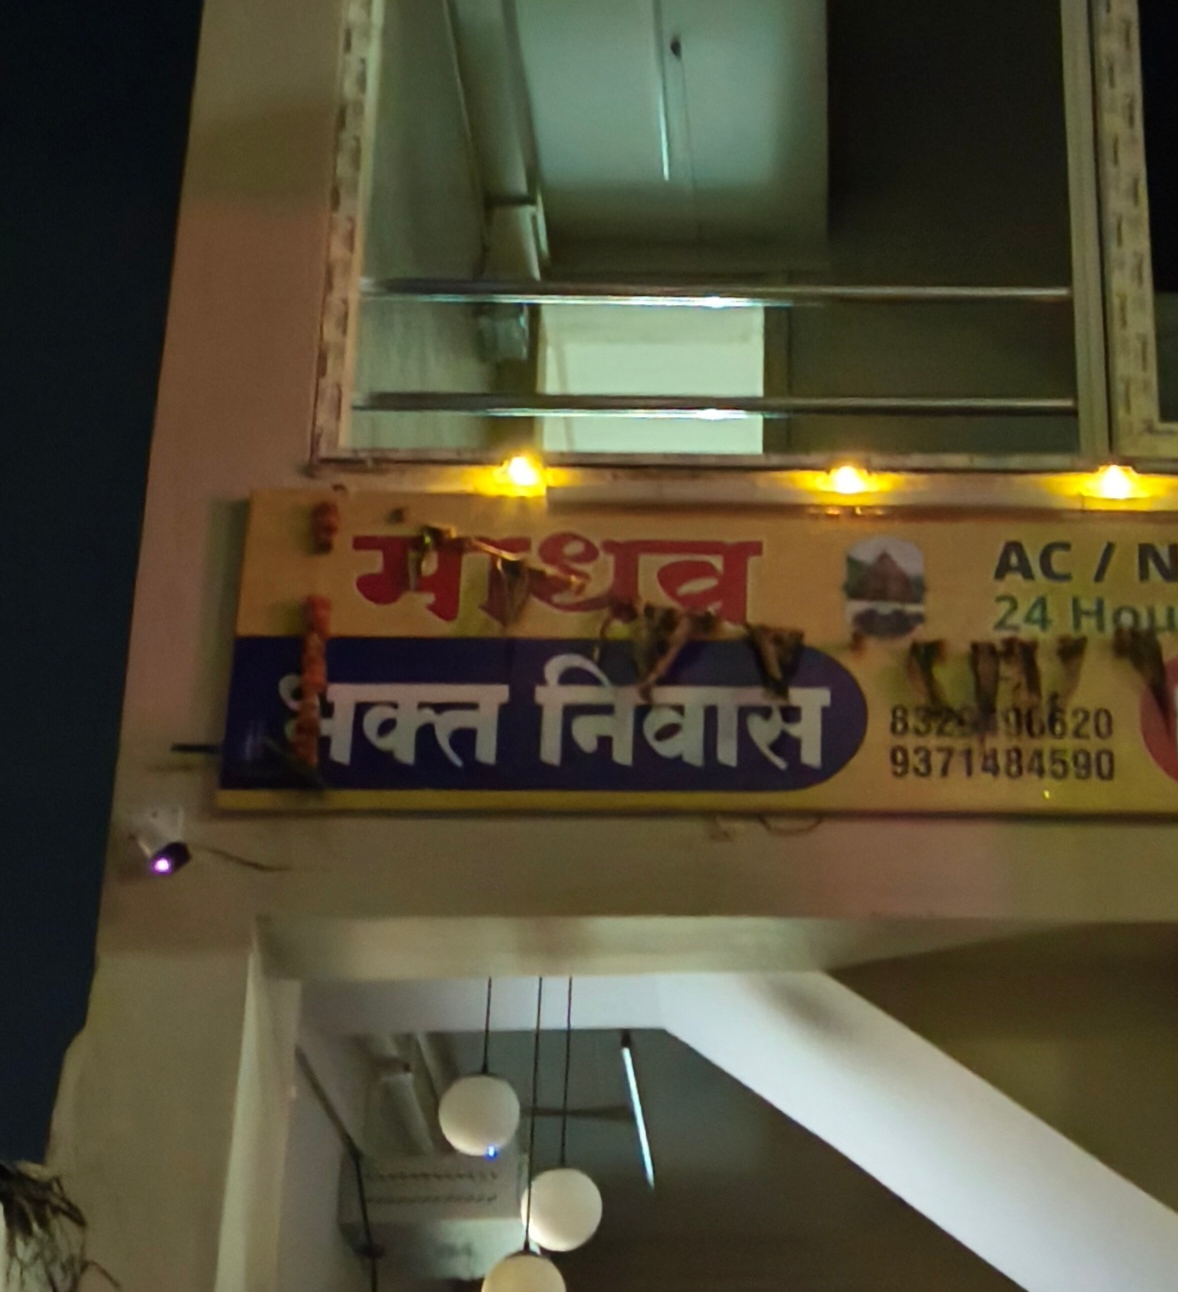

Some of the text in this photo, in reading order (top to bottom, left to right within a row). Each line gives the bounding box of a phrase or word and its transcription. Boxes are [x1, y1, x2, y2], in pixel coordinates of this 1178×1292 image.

[352, 530, 764, 624] माधव
[993, 541, 1073, 582] AC
[993, 594, 1050, 633] 24
[534, 653, 831, 770] निवास
[889, 703, 1114, 740] 83296620
[889, 743, 1116, 782] 9371484590
